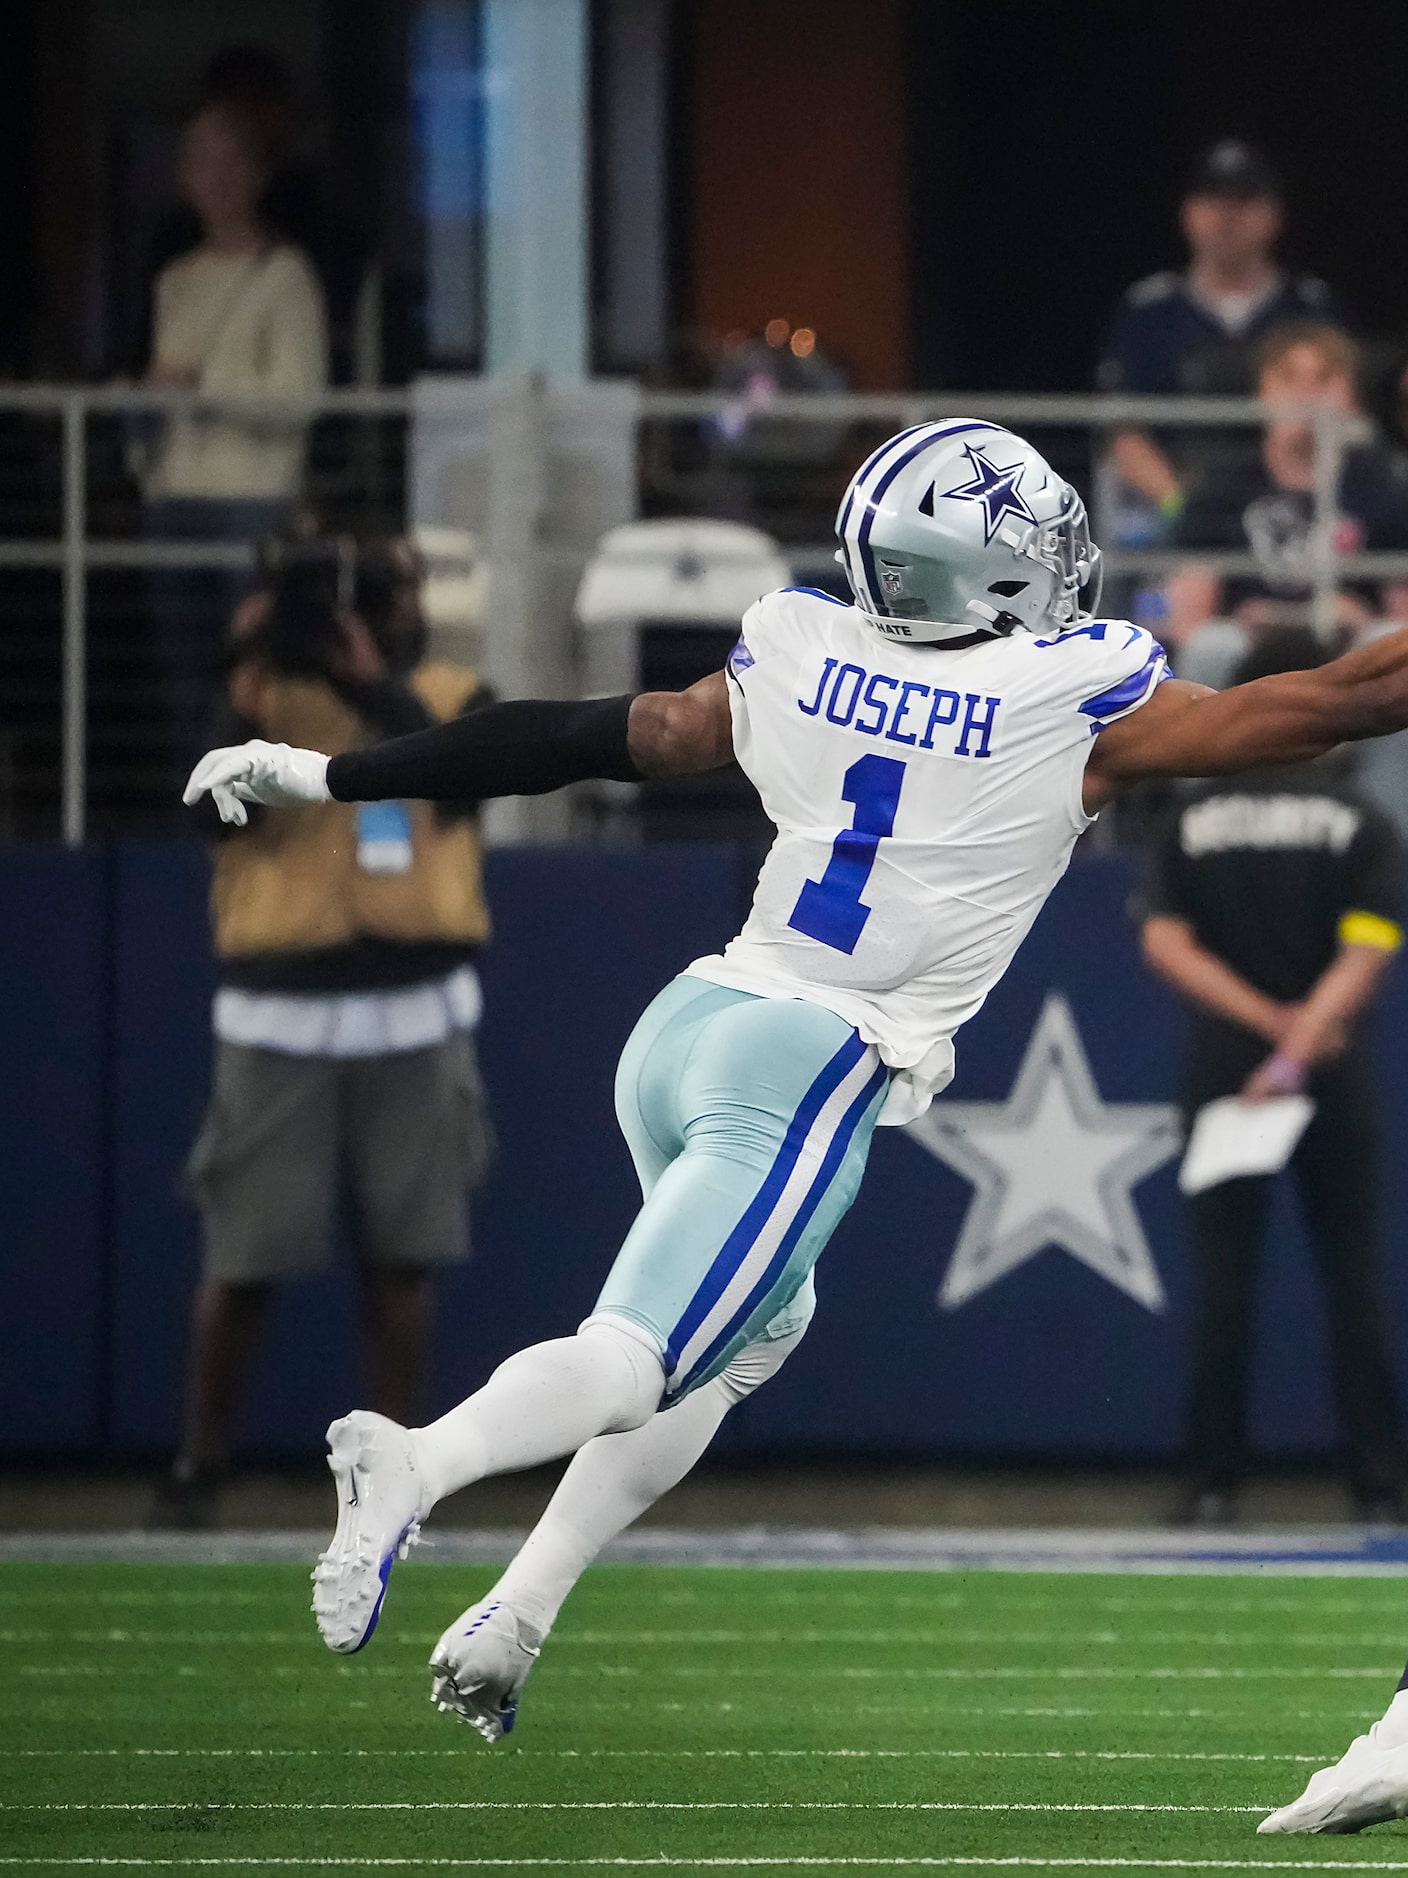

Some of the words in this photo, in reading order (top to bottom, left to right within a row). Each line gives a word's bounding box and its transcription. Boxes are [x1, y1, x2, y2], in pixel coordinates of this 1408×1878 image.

[875, 622, 912, 636] HATE
[797, 657, 1001, 758] JOSEPH
[787, 753, 907, 956] 1
